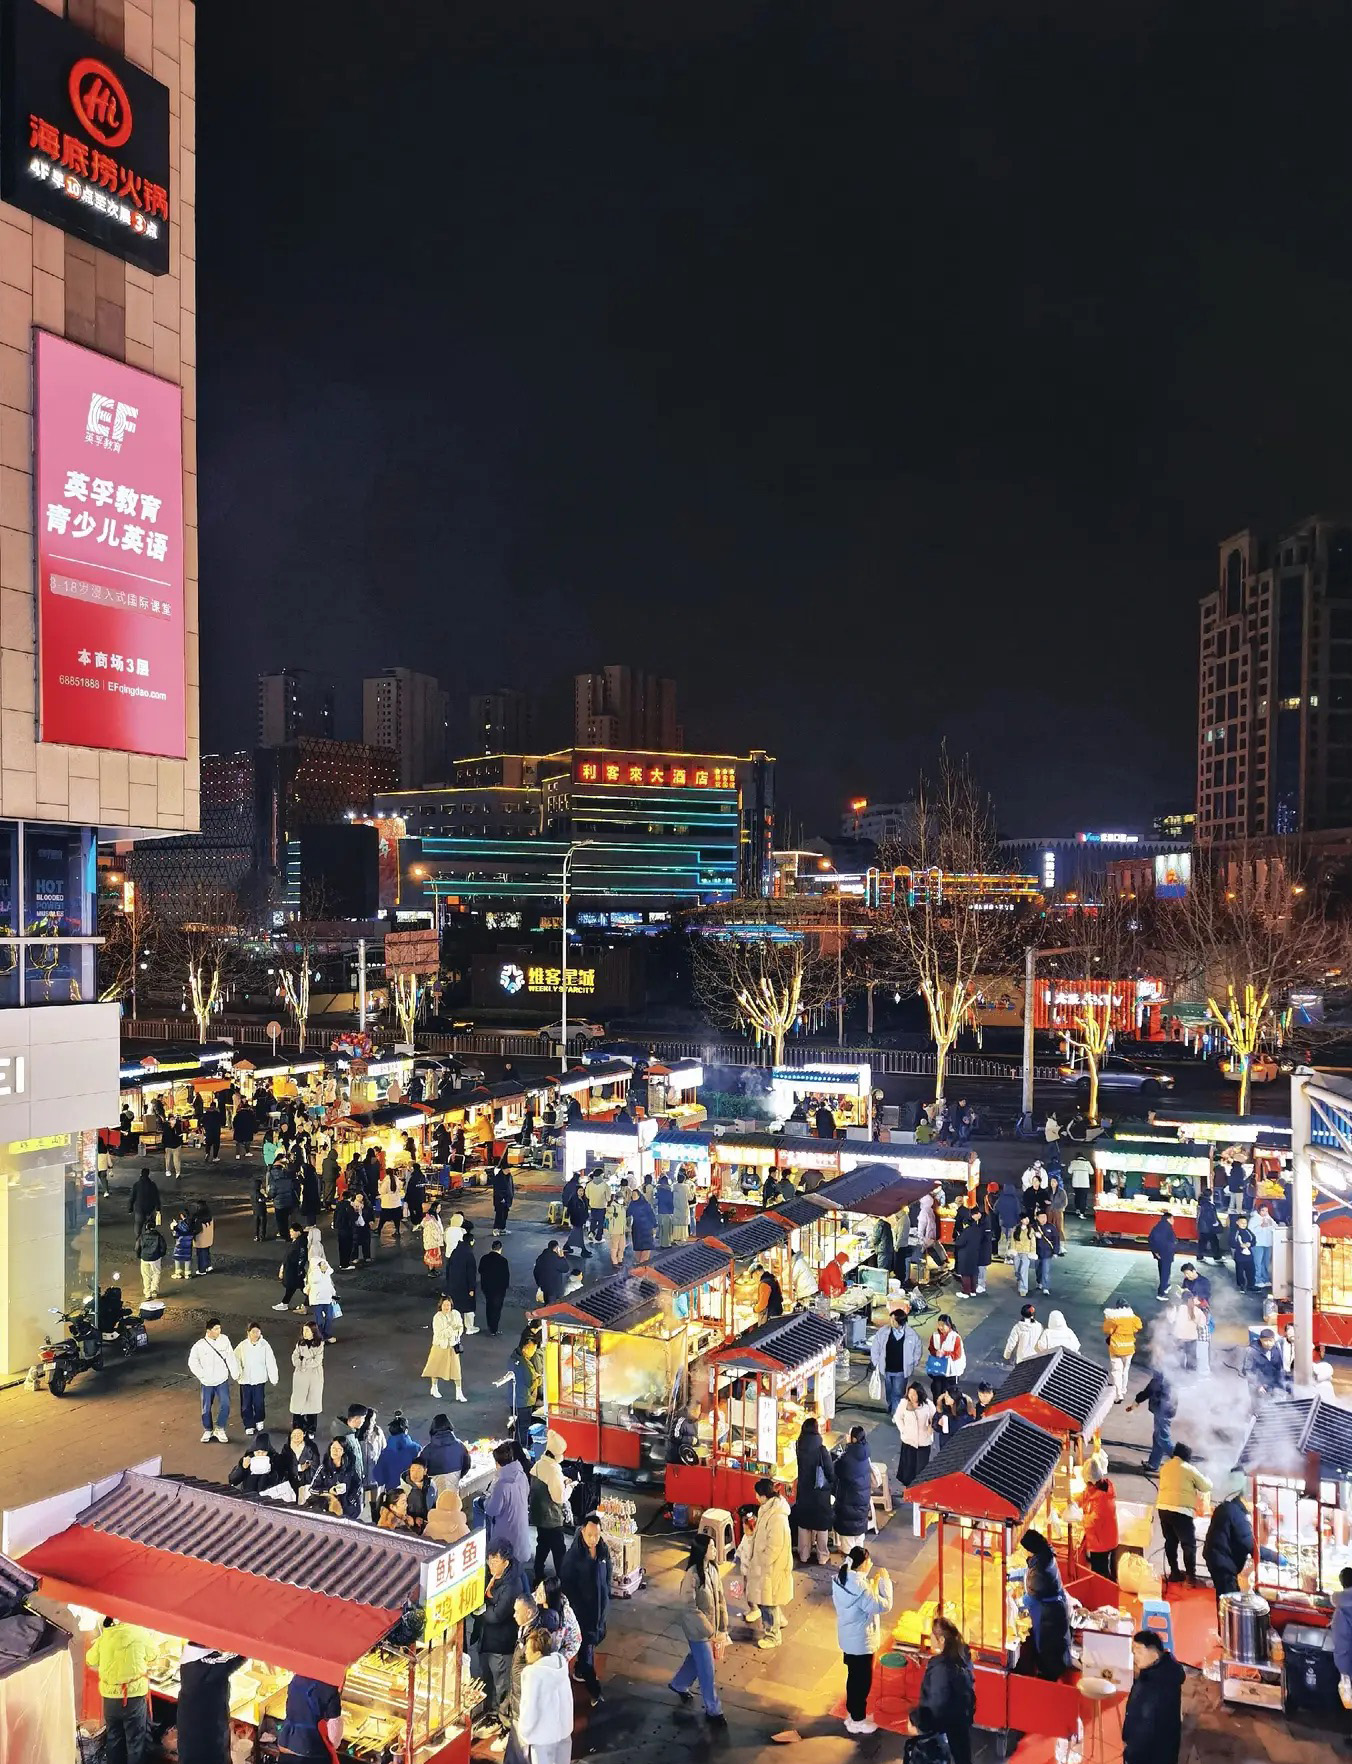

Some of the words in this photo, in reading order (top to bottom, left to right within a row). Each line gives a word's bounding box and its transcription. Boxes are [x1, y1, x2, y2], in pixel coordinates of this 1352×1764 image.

[29, 113, 168, 221] 海底捞火锅
[86, 393, 139, 441] EF
[84, 432, 122, 454] 英孚教育
[64, 470, 162, 523] 英孚教育
[46, 503, 169, 562] 青少儿英语
[78, 648, 149, 676] 本商场3层
[59, 675, 100, 689] 68851888
[108, 682, 167, 700] EFqingdao.com
[36, 880, 64, 893] HOT
[528, 967, 595, 986] 维客星城
[528, 985, 595, 994] WEEKLYSARCITY
[436, 1540, 478, 1588] 鱿鱼
[433, 1581, 478, 1630] 鸡柳
